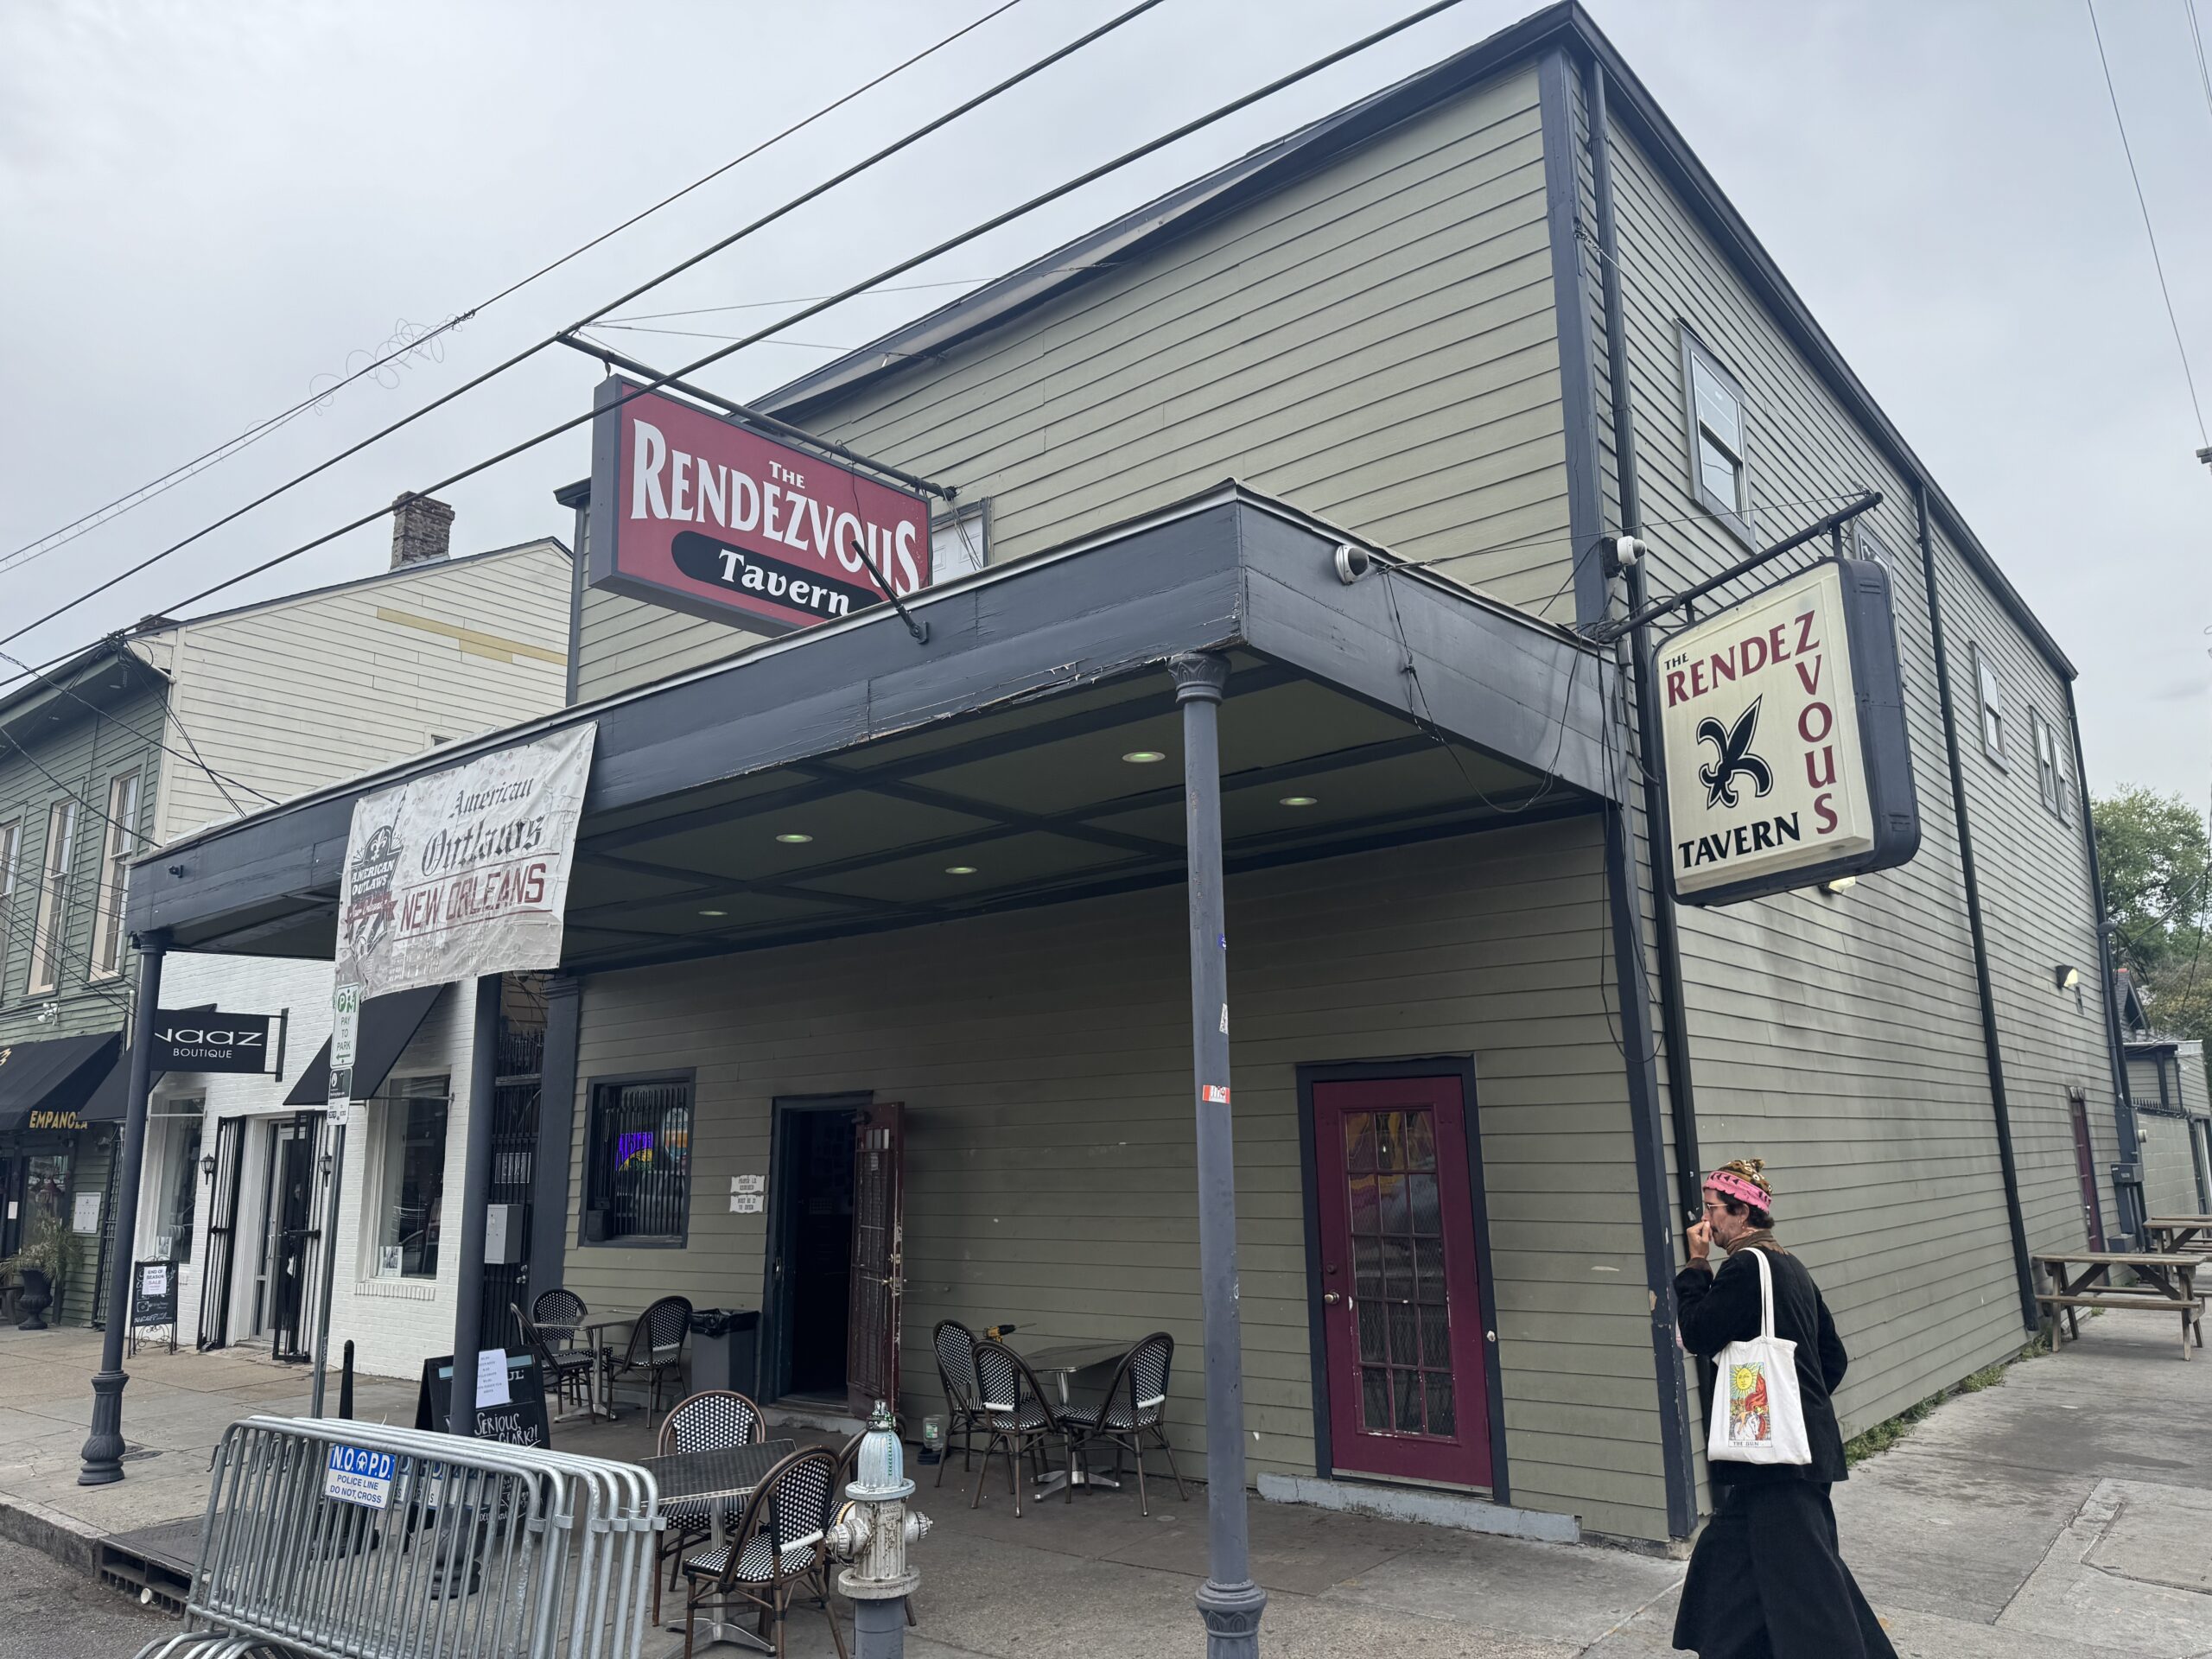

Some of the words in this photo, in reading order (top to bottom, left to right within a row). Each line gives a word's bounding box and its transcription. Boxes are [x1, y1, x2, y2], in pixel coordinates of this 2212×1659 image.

[768, 460, 805, 489] THE
[630, 418, 919, 598] RENDEZVOUS
[718, 548, 850, 616] Tavern
[1664, 652, 1690, 671] THE
[448, 778, 535, 818] American
[421, 813, 546, 877] Outlaws
[1678, 811, 1801, 868] TAVERN
[352, 859, 395, 883] AMERICAN
[352, 874, 389, 896] OUTLAWS
[400, 885, 444, 932] NEW
[445, 862, 547, 921] ORLEANS
[340, 1016, 351, 1026] PAY
[341, 1029, 349, 1038] TO
[173, 1048, 232, 1058] BOUTIQUE
[336, 1040, 351, 1052] PARK
[330, 1485, 340, 1494] DO
[341, 1487, 356, 1497] NOT
[357, 1491, 382, 1503] CROSS
[337, 1474, 362, 1487] POLICE
[363, 1479, 378, 1491] LINE
